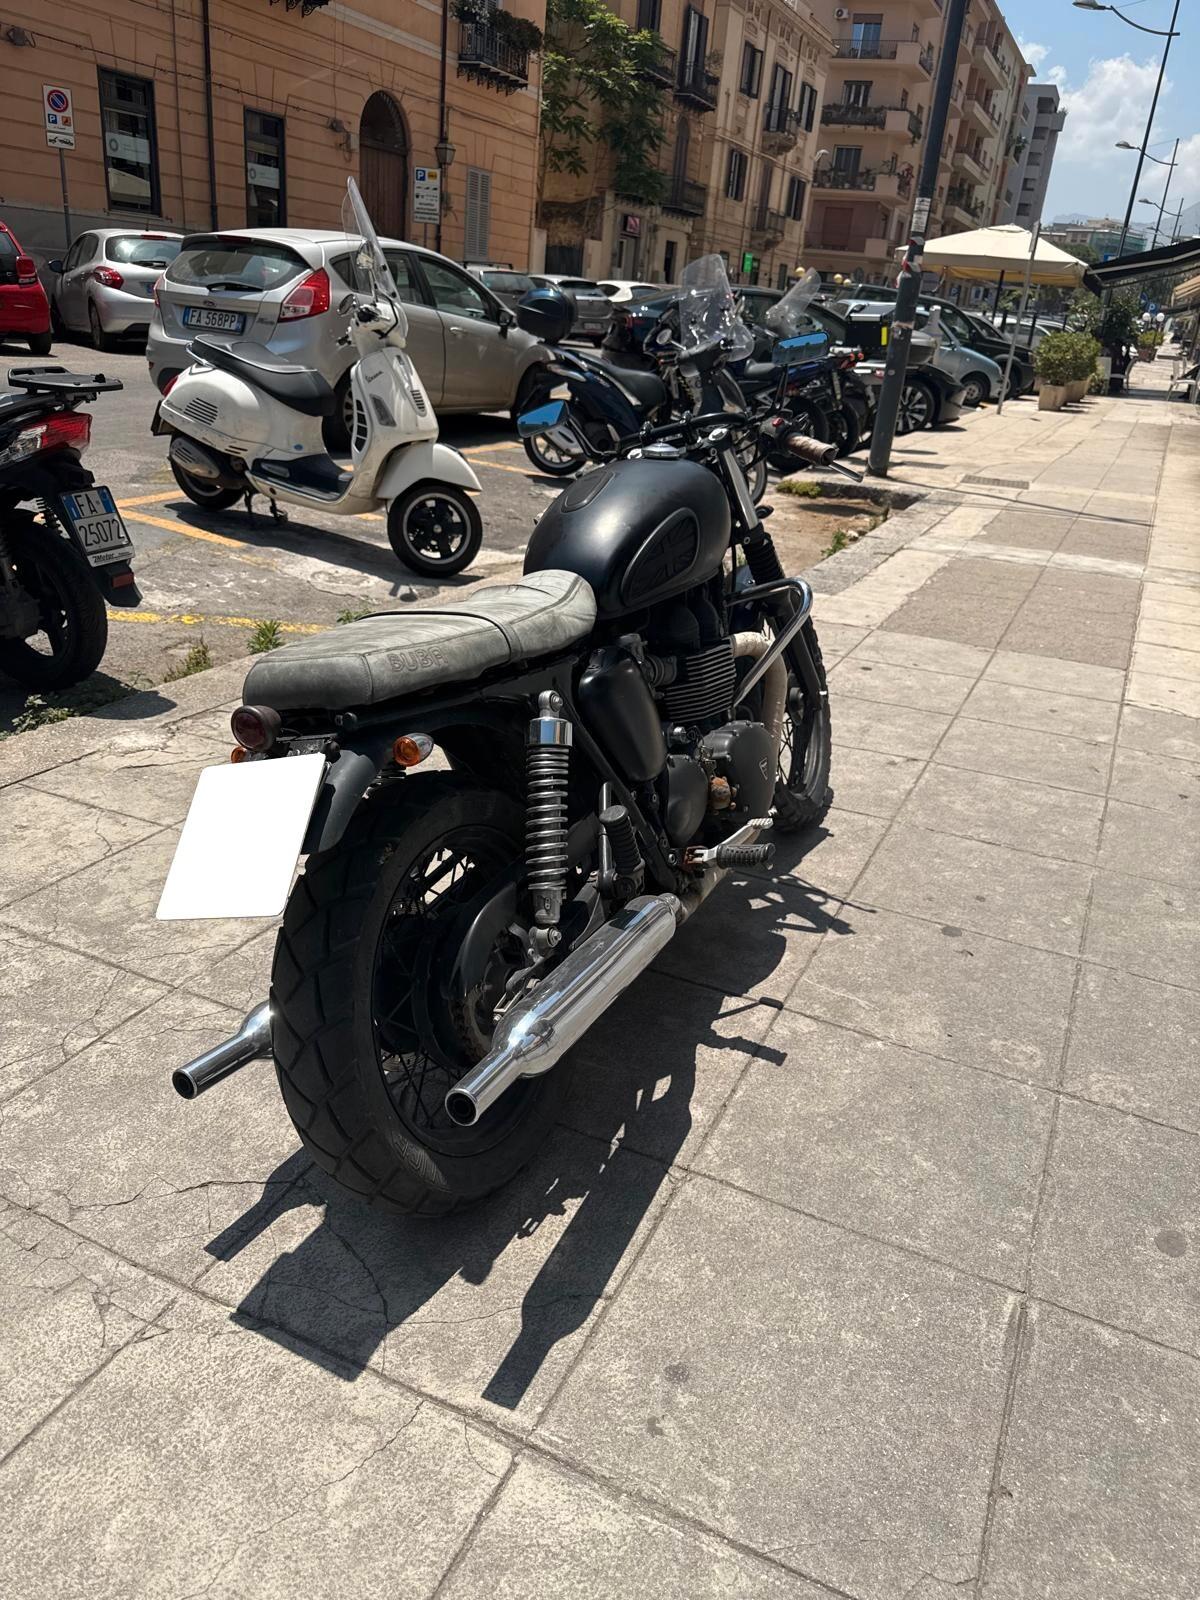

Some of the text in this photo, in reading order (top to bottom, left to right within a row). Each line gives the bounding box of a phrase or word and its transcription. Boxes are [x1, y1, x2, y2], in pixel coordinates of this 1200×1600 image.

[190, 310, 236, 329] FA 568PP
[74, 493, 98, 516] FA
[79, 518, 125, 547] 25072
